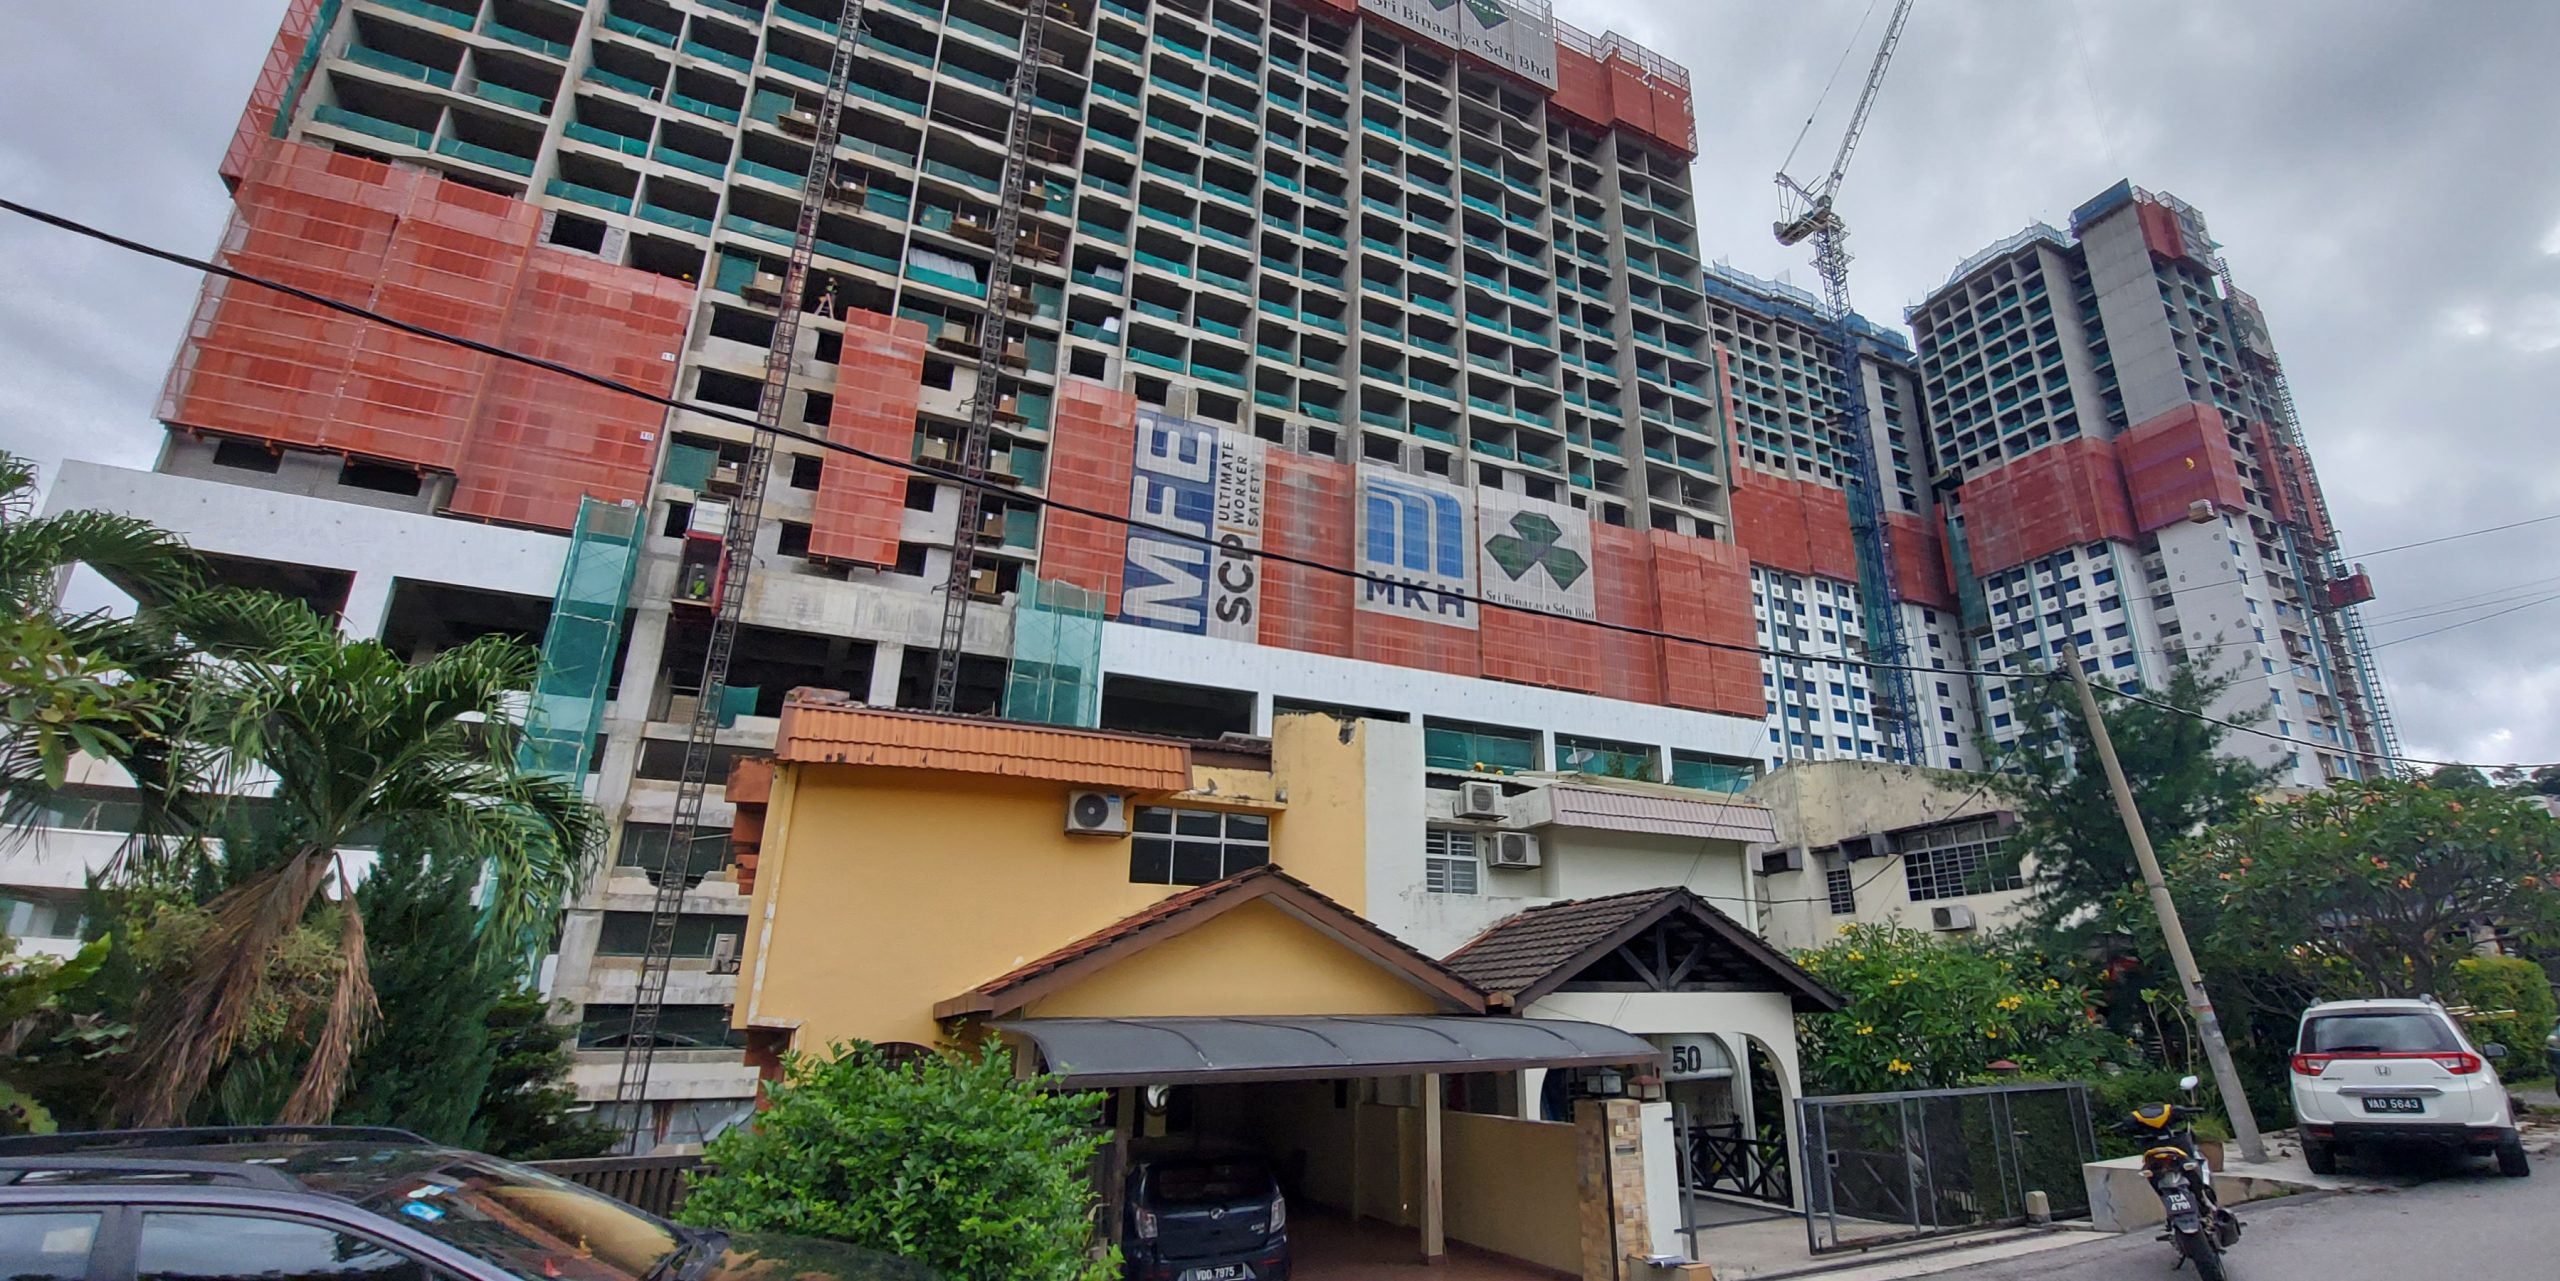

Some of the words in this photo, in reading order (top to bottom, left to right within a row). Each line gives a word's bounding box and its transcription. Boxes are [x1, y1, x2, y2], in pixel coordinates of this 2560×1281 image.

[1402, 5, 1481, 49] Binaraya
[1484, 39, 1515, 63] Sdn
[1519, 55, 1551, 79] Bhd
[1217, 441, 1235, 522] ULTIMATE
[1232, 455, 1249, 524] WORKER
[1122, 417, 1213, 627] MFE
[1215, 533, 1255, 627] SCP
[1365, 569, 1466, 618] MKH
[1486, 590, 1502, 602] Sri
[1552, 603, 1573, 615] Sdn
[1574, 608, 1596, 620] Bhd
[1671, 1045, 1702, 1074] 50
[2366, 1098, 2387, 1108] VAD
[2389, 1098, 2418, 1108] 5643
[1215, 1266, 1235, 1278] 7975
